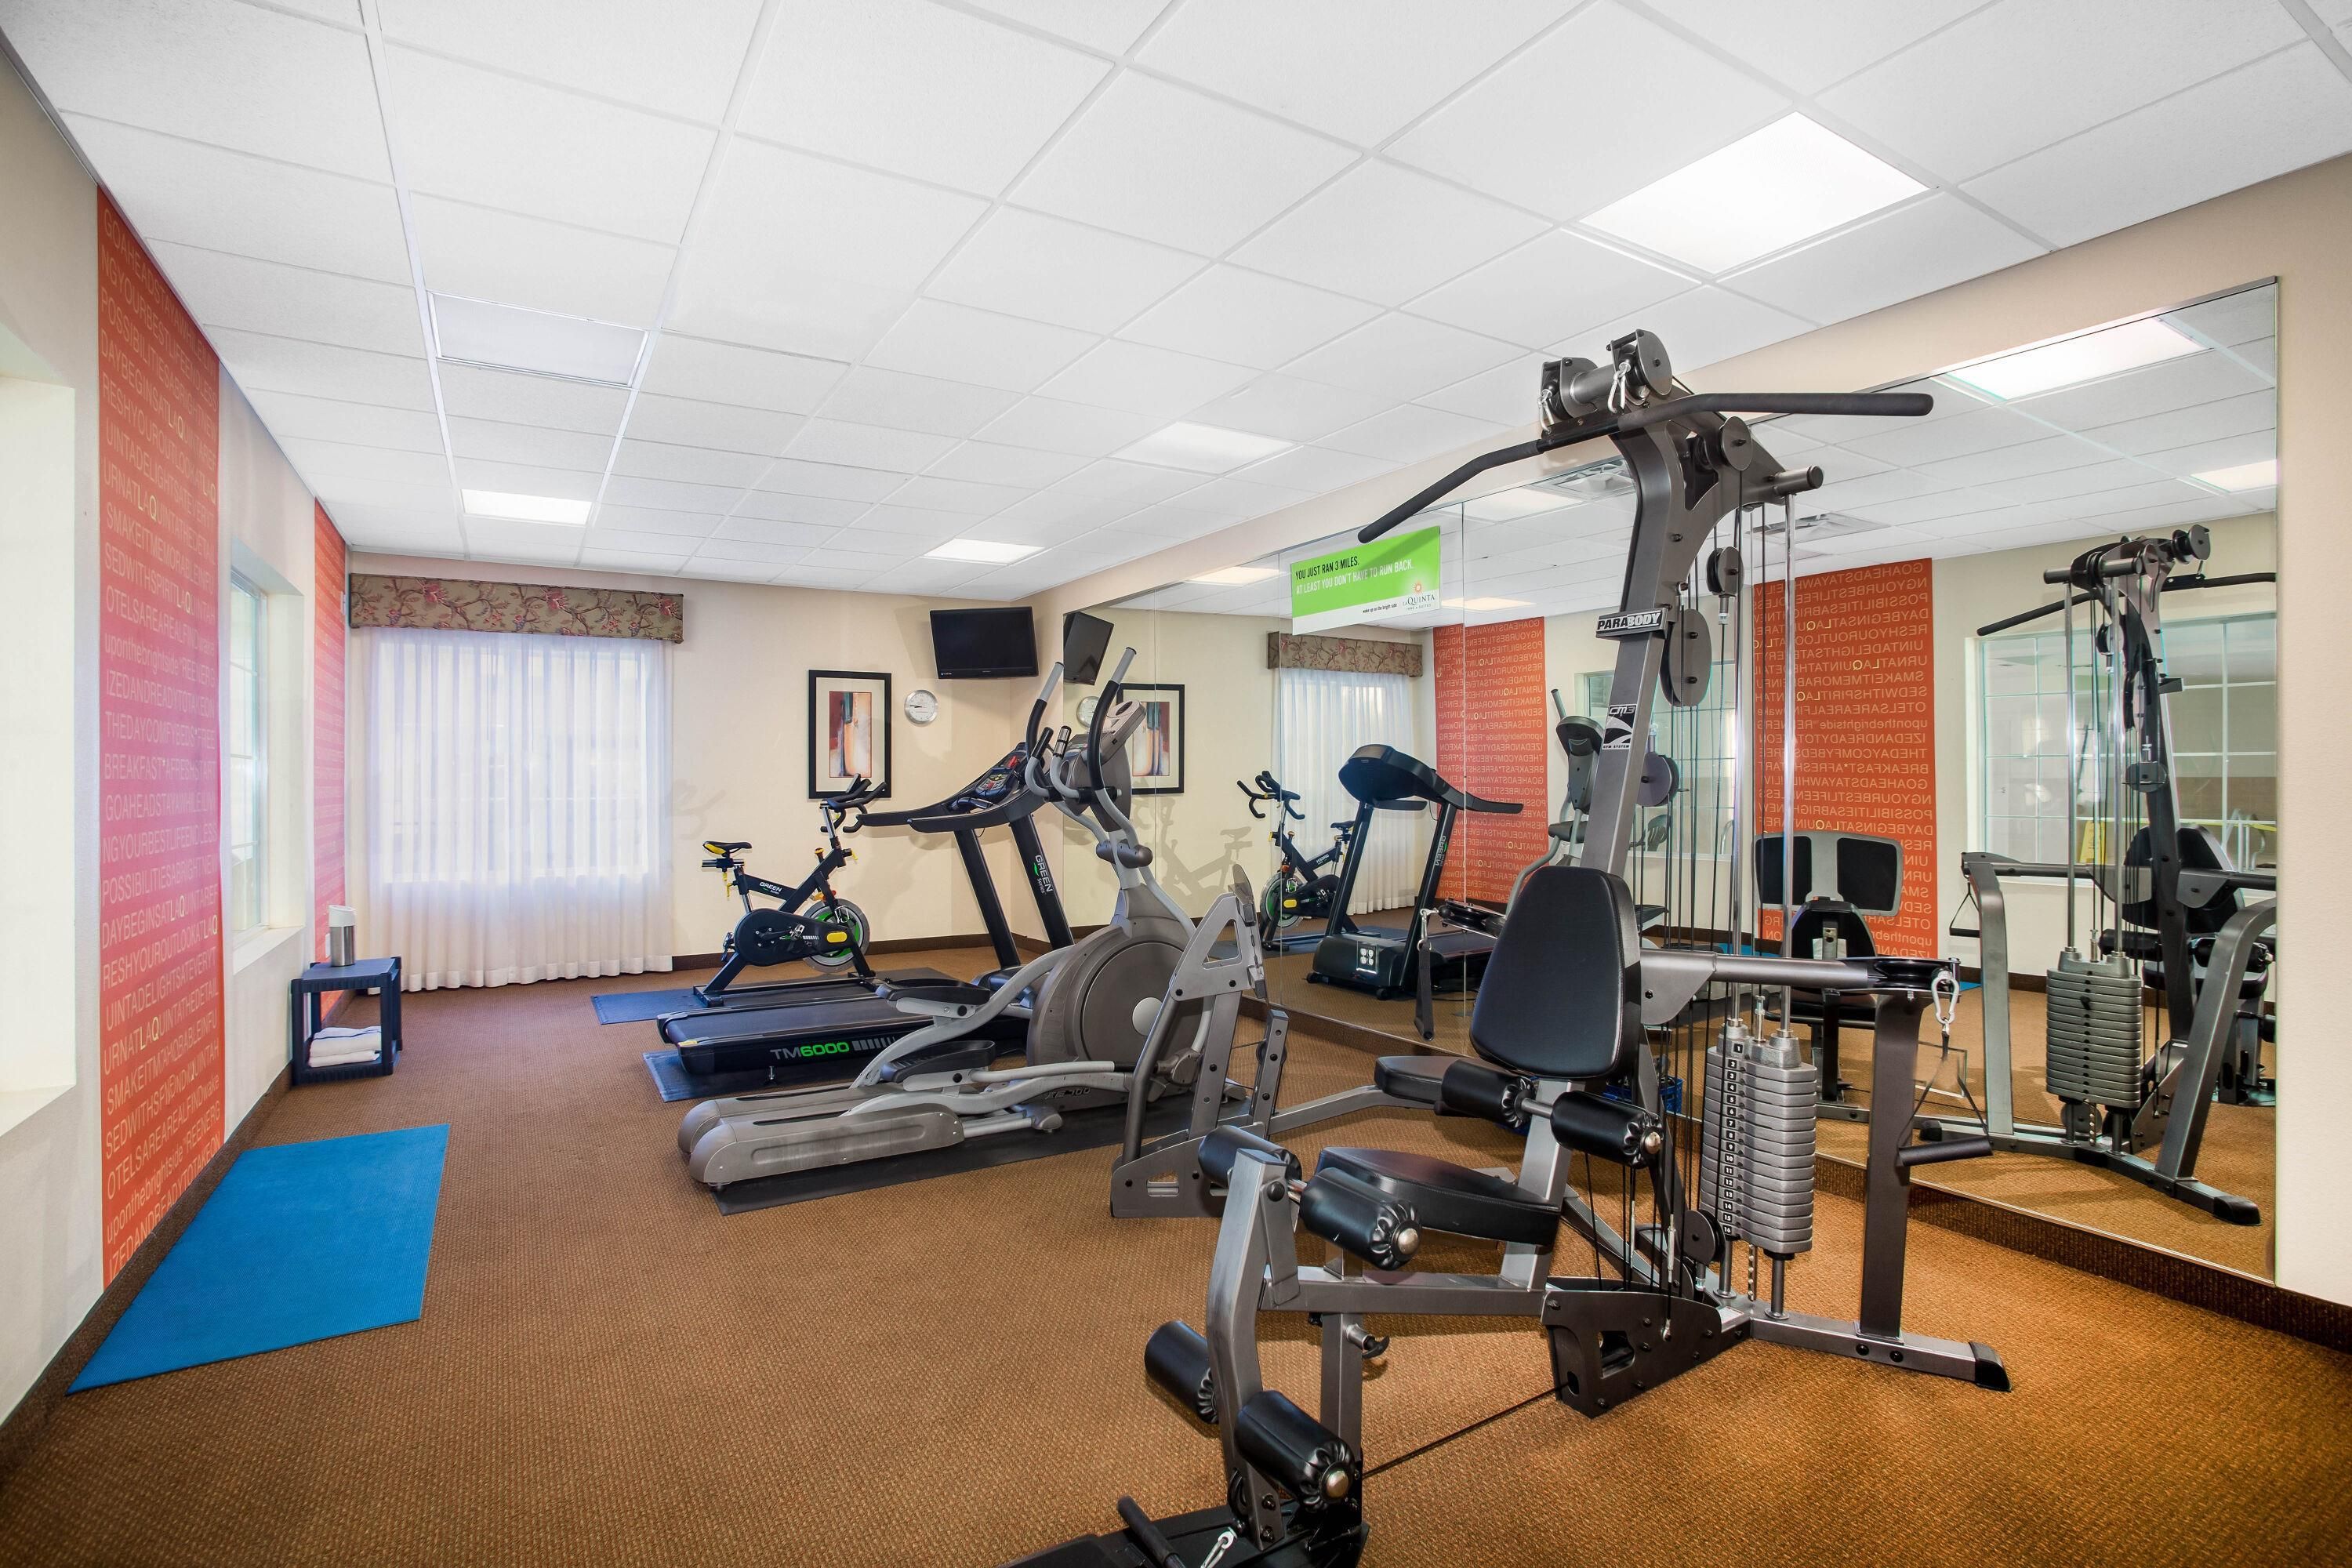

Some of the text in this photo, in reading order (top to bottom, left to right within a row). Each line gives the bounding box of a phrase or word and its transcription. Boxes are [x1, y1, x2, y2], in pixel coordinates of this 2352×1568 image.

[1295, 556, 1359, 580] YOU JUST RAN 3 MILES.
[1296, 584, 1302, 596] AT
[1304, 581, 1320, 593] LEAST
[1322, 579, 1333, 589] YOU
[1335, 573, 1351, 586] DON'T
[1353, 568, 1367, 581] HAVE
[1370, 567, 1377, 578] TO
[1380, 564, 1392, 575] RUN
[1597, 612, 1661, 630] PARABODY
[1035, 855, 1053, 892] GREEN
[760, 882, 782, 892] GREEN
[770, 1042, 850, 1059] TM6000
